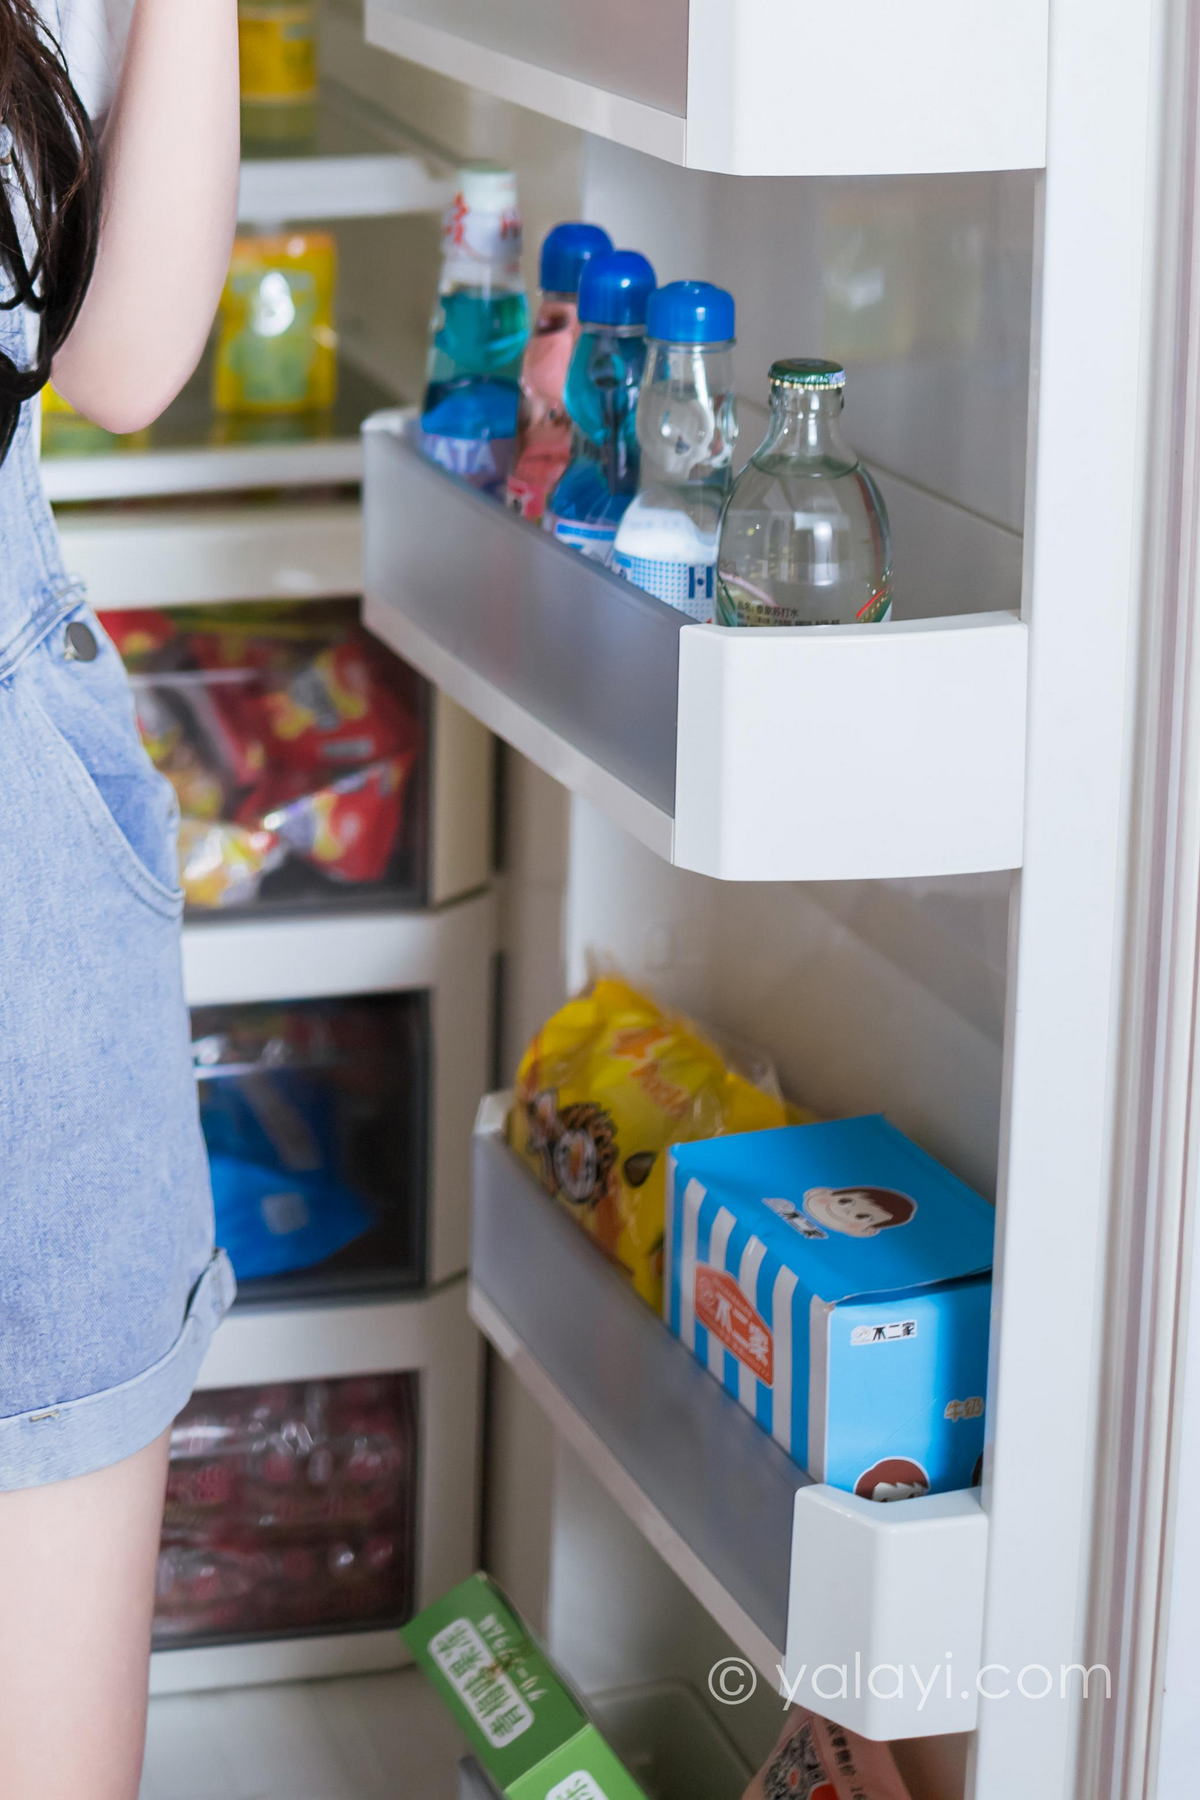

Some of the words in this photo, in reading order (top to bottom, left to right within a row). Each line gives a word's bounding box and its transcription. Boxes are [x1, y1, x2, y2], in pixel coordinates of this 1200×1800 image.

[714, 1292, 769, 1367] 不二家
[872, 1321, 916, 1341] 不二家
[435, 1624, 529, 1737] 青梅味果冻
